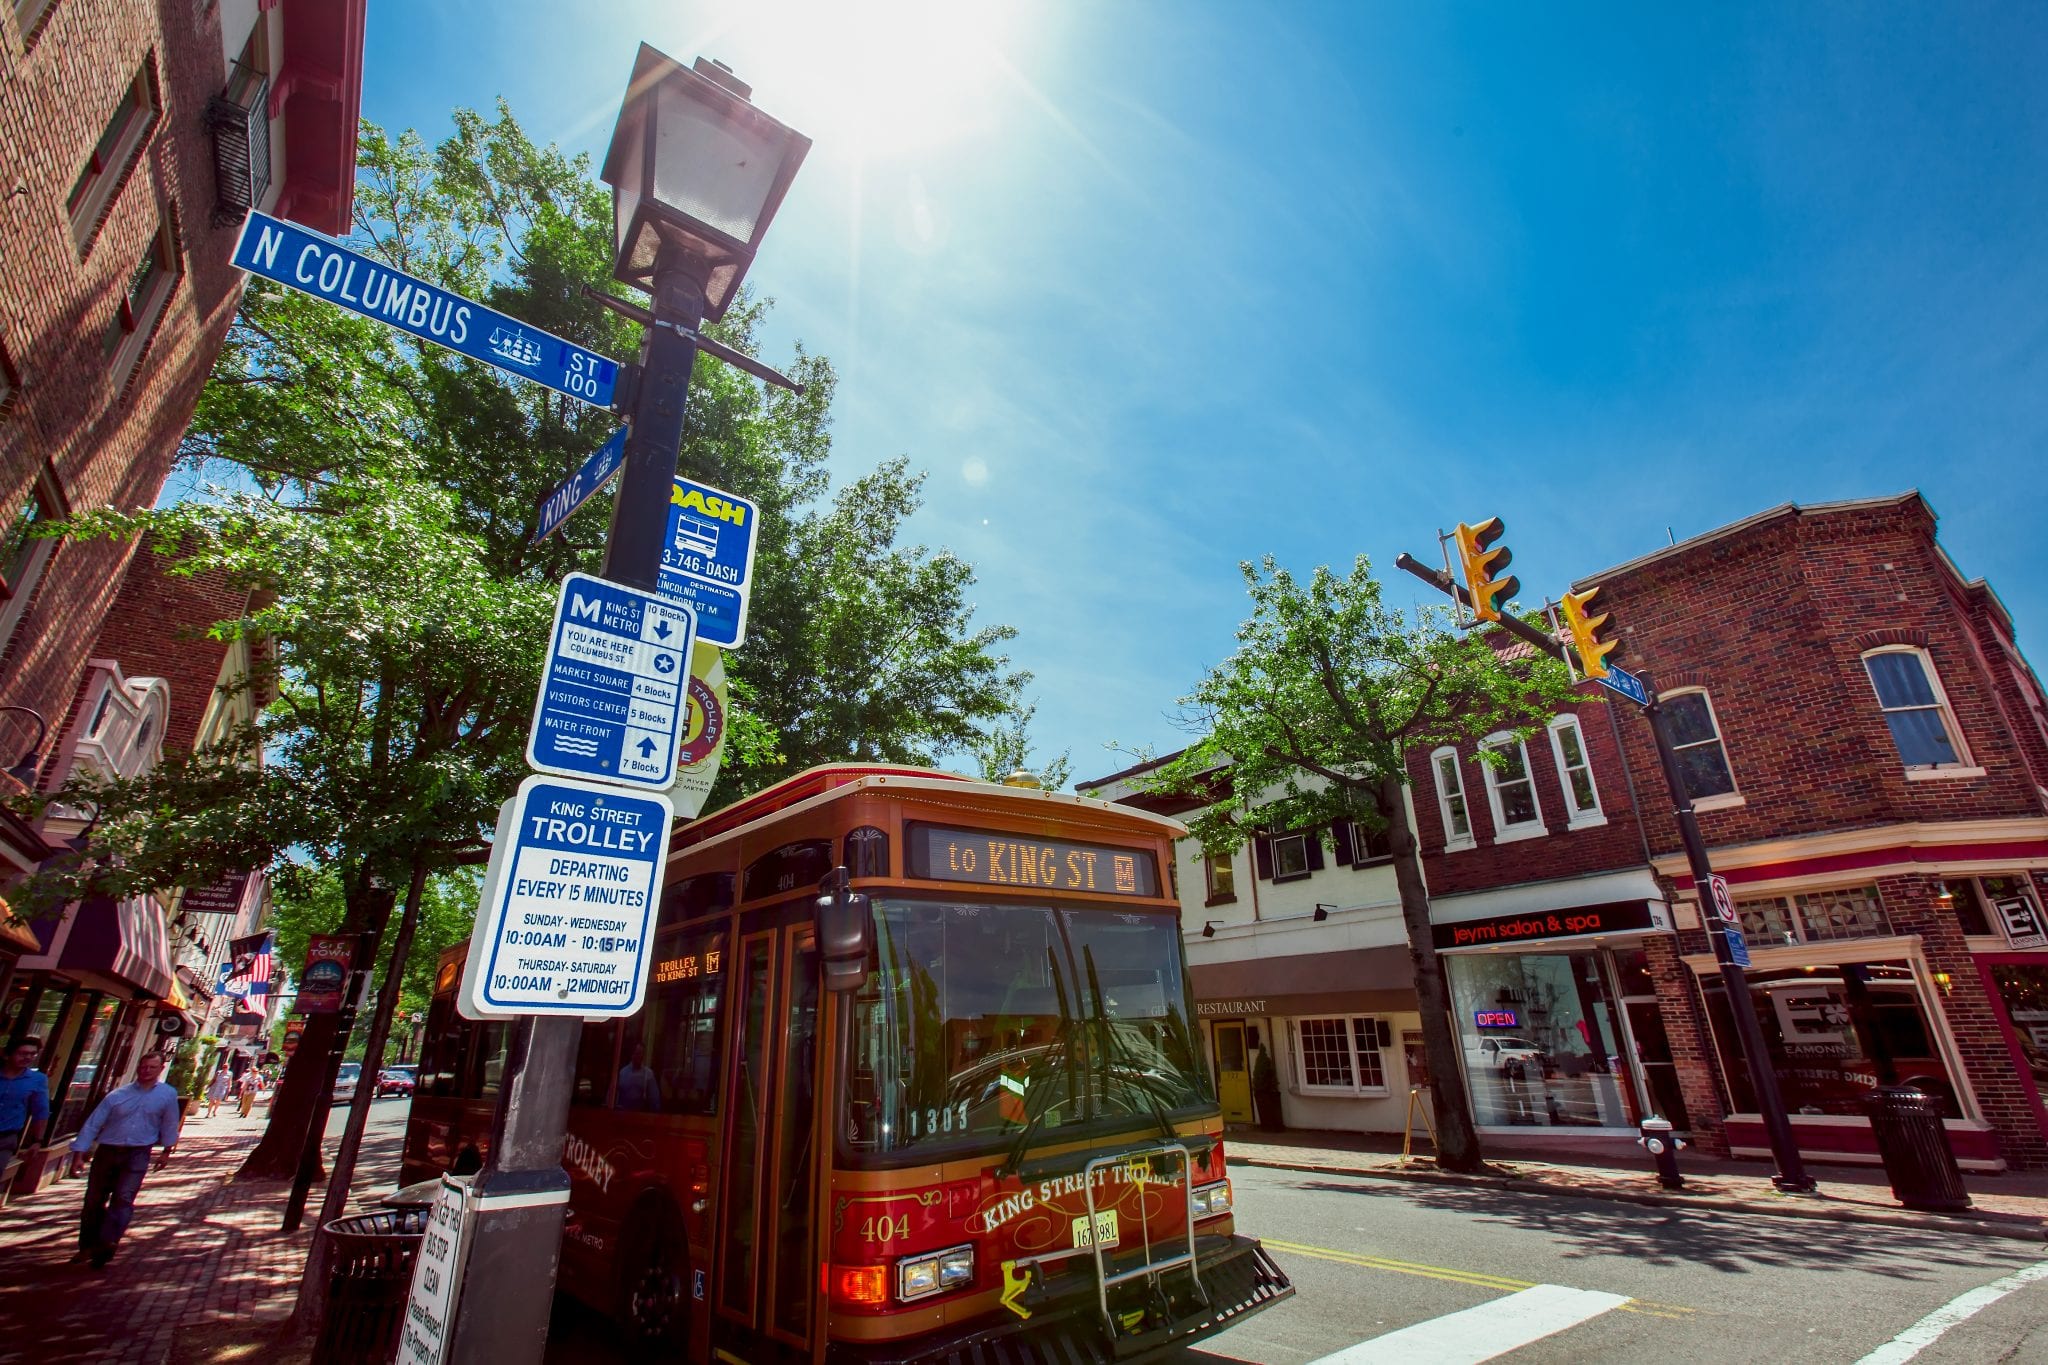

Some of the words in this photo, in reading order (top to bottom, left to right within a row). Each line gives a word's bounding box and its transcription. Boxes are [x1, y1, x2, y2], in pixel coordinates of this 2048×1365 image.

[252, 225, 284, 270] N
[295, 244, 471, 344] COLUMBUS
[570, 352, 599, 377] ST
[564, 370, 597, 398] 100
[543, 474, 582, 532] KING
[670, 483, 746, 527] DASH
[656, 578, 697, 598] LINCOLNIA
[690, 581, 734, 598] DESTINATION
[570, 593, 602, 623] M
[605, 601, 628, 616] KING
[630, 608, 641, 619] ST
[648, 604, 658, 614] 10
[659, 608, 685, 622] Blocks
[695, 601, 706, 612] ST
[708, 606, 718, 615] M
[602, 614, 640, 634] METRO
[567, 629, 587, 643] YOU
[589, 638, 607, 649] ARE
[611, 641, 634, 655] HERE
[570, 643, 613, 661] COLUMBUS
[615, 655, 626, 664] ST.
[554, 663, 591, 680] MARKET
[593, 673, 629, 689] SQUARE
[549, 690, 591, 708] VISITORS
[592, 700, 627, 715] CENTER
[635, 684, 642, 692] 4
[644, 685, 671, 699] Blocks
[630, 709, 637, 718] 5
[639, 710, 666, 724] Blocks
[694, 685, 717, 744] TROLLEY
[545, 717, 577, 732] WATER
[580, 724, 612, 739] FRONT
[623, 759, 629, 767] 7
[631, 760, 659, 774] Blocks
[550, 801, 585, 818] KING
[590, 807, 642, 826] STREET
[531, 816, 654, 853] TROLLEY
[550, 858, 629, 882] DEPARTING
[948, 841, 976, 872] to
[988, 841, 1057, 886] KING
[1066, 850, 1097, 889] ST
[516, 878, 566, 900] EVERY
[569, 884, 581, 901] 15
[584, 885, 644, 907] MINUTES
[777, 872, 794, 890] 404
[523, 913, 564, 927] SUNDAY
[570, 917, 627, 932] WEDNESDAY
[1454, 922, 1497, 944] jeymi
[1500, 919, 1544, 937] salon
[1549, 916, 1561, 931] &
[1565, 914, 1601, 933] spa
[1999, 901, 2033, 934] E
[505, 930, 566, 948] 10:00AM
[570, 962, 617, 975] SATURDAY
[656, 973, 666, 982] TO
[667, 969, 686, 981] KING
[688, 967, 699, 977] ST
[660, 956, 696, 973] TROLLEY
[494, 974, 552, 991] 10:00AM
[1197, 1000, 1266, 1015] RESTAURANT
[1477, 1012, 1515, 1026] OPEN
[1770, 985, 1846, 1044] E
[1785, 1045, 1858, 1054] EAMONN'S
[983, 1189, 1034, 1234] KING
[1040, 1168, 1106, 1202] STREET
[859, 1213, 910, 1243] 404
[424, 1266, 440, 1297] CLEAN
